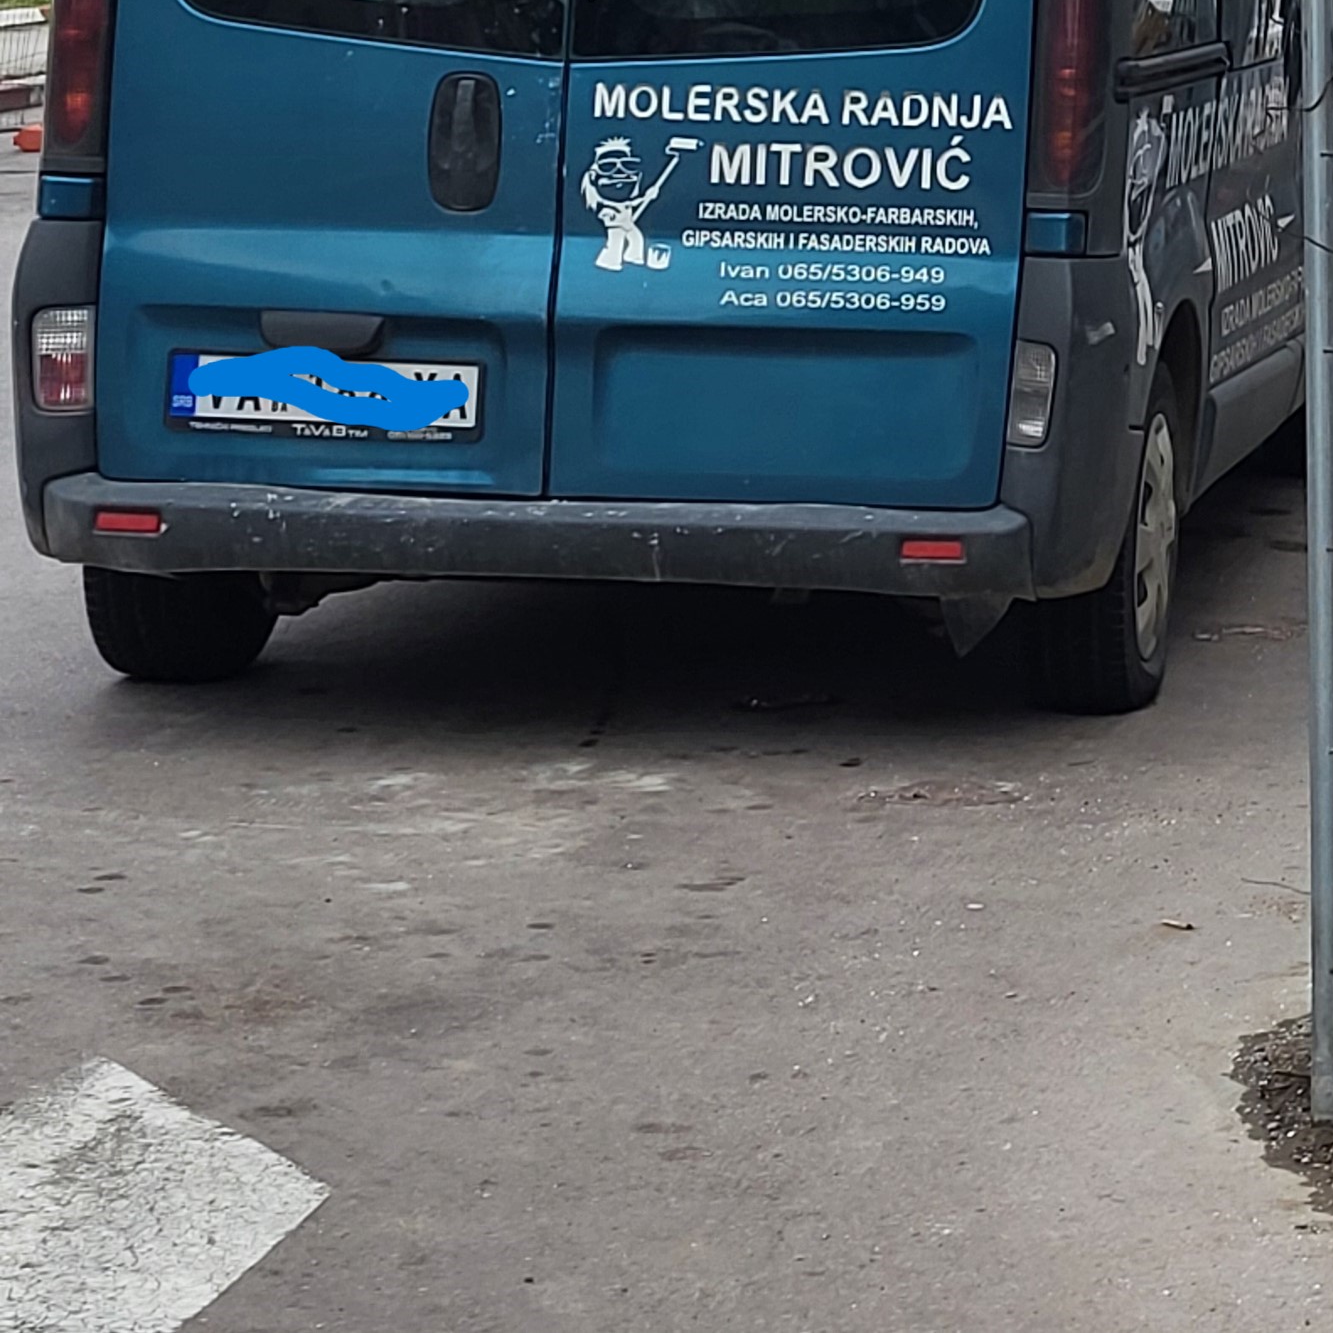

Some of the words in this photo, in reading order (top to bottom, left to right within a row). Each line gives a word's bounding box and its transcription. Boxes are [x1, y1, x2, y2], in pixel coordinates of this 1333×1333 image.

[593, 83, 830, 125] MOLERSKA
[842, 91, 1013, 131] RADNJA
[709, 135, 971, 190] MITROVIĆ
[698, 202, 763, 222] IZRADA
[766, 204, 979, 229] MOLERSKO-FARBARSKIH,
[682, 229, 785, 250] GIPSARSKIH
[798, 233, 917, 254] FASADERSKIH
[921, 234, 991, 256] RADOVA
[720, 262, 770, 281] Ivan
[779, 263, 945, 284] 065/5306-949
[719, 291, 768, 309] Aca
[776, 291, 946, 312] 065/5306-959
